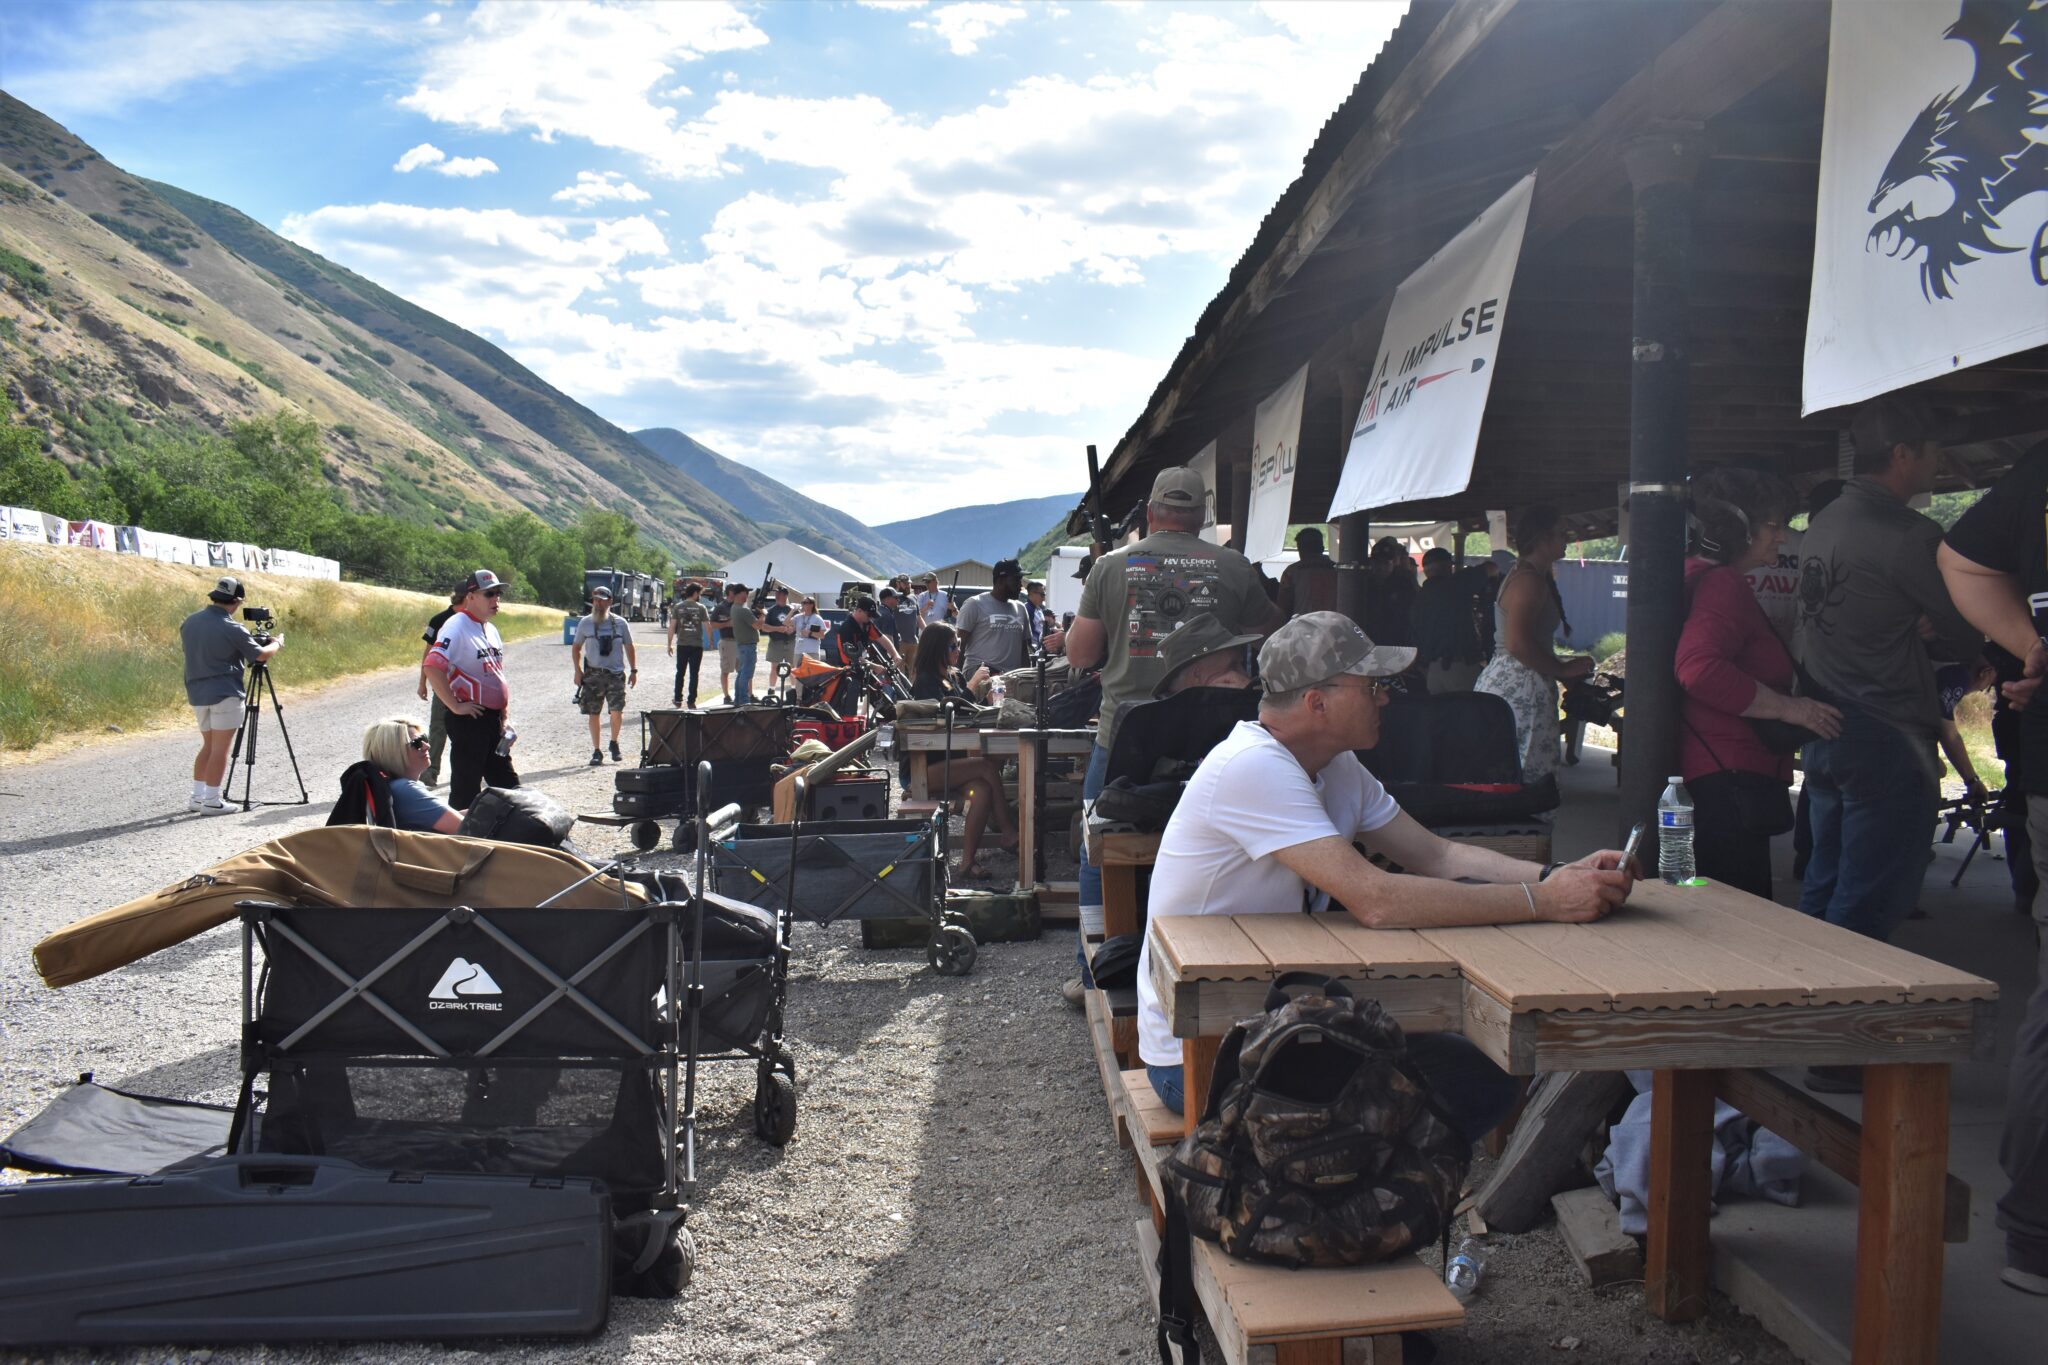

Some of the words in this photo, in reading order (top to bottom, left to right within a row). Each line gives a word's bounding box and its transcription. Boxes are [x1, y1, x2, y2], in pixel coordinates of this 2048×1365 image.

[1398, 299, 1499, 377] IMPULSE
[1383, 376, 1418, 415] AIR
[989, 613, 1023, 625] FX
